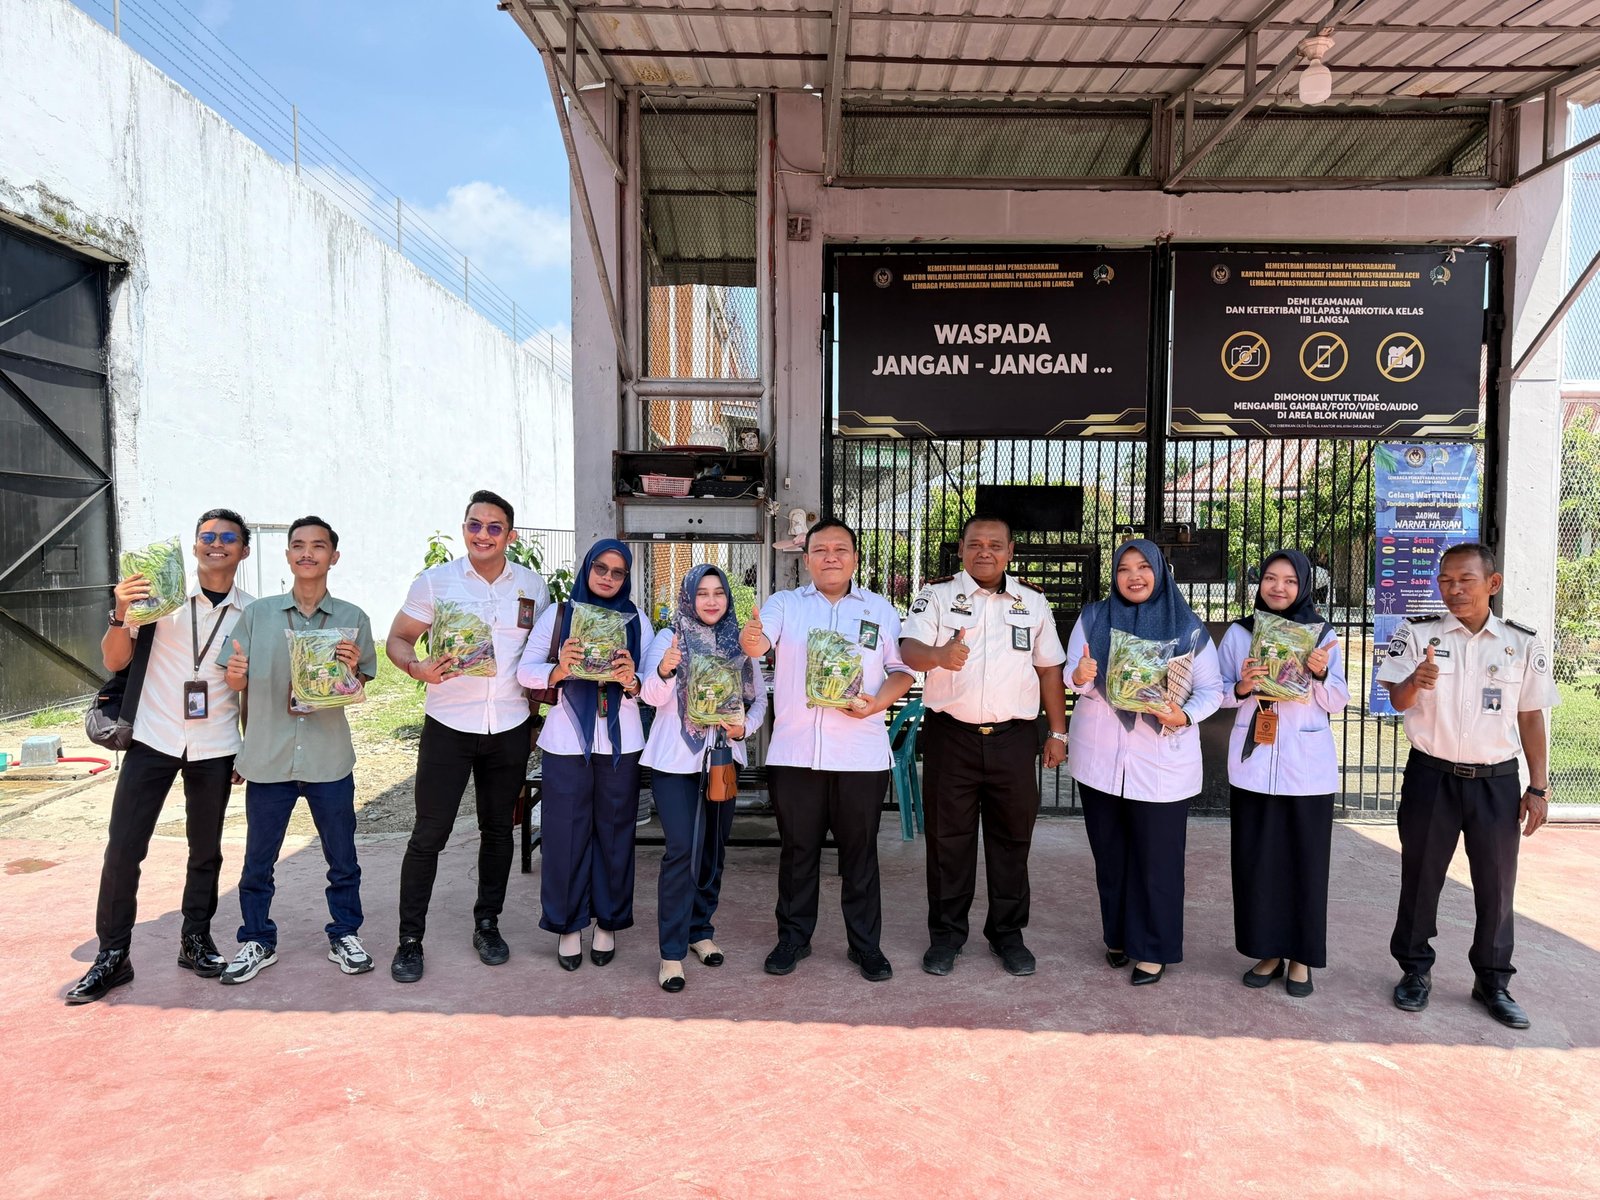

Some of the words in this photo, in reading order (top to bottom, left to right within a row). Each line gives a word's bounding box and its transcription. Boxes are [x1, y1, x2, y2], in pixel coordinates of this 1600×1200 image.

[934, 323, 1051, 345] WASPADA
[872, 355, 969, 376] JANGAN
[989, 354, 1087, 375] JANGAN
[1094, 366, 1113, 374] ...
[1234, 402, 1287, 410] MENGAMBIL
[1290, 402, 1418, 411] GAMBAR/FOTO/VIDEO/AUDIO
[1395, 521, 1427, 529] WARNA
